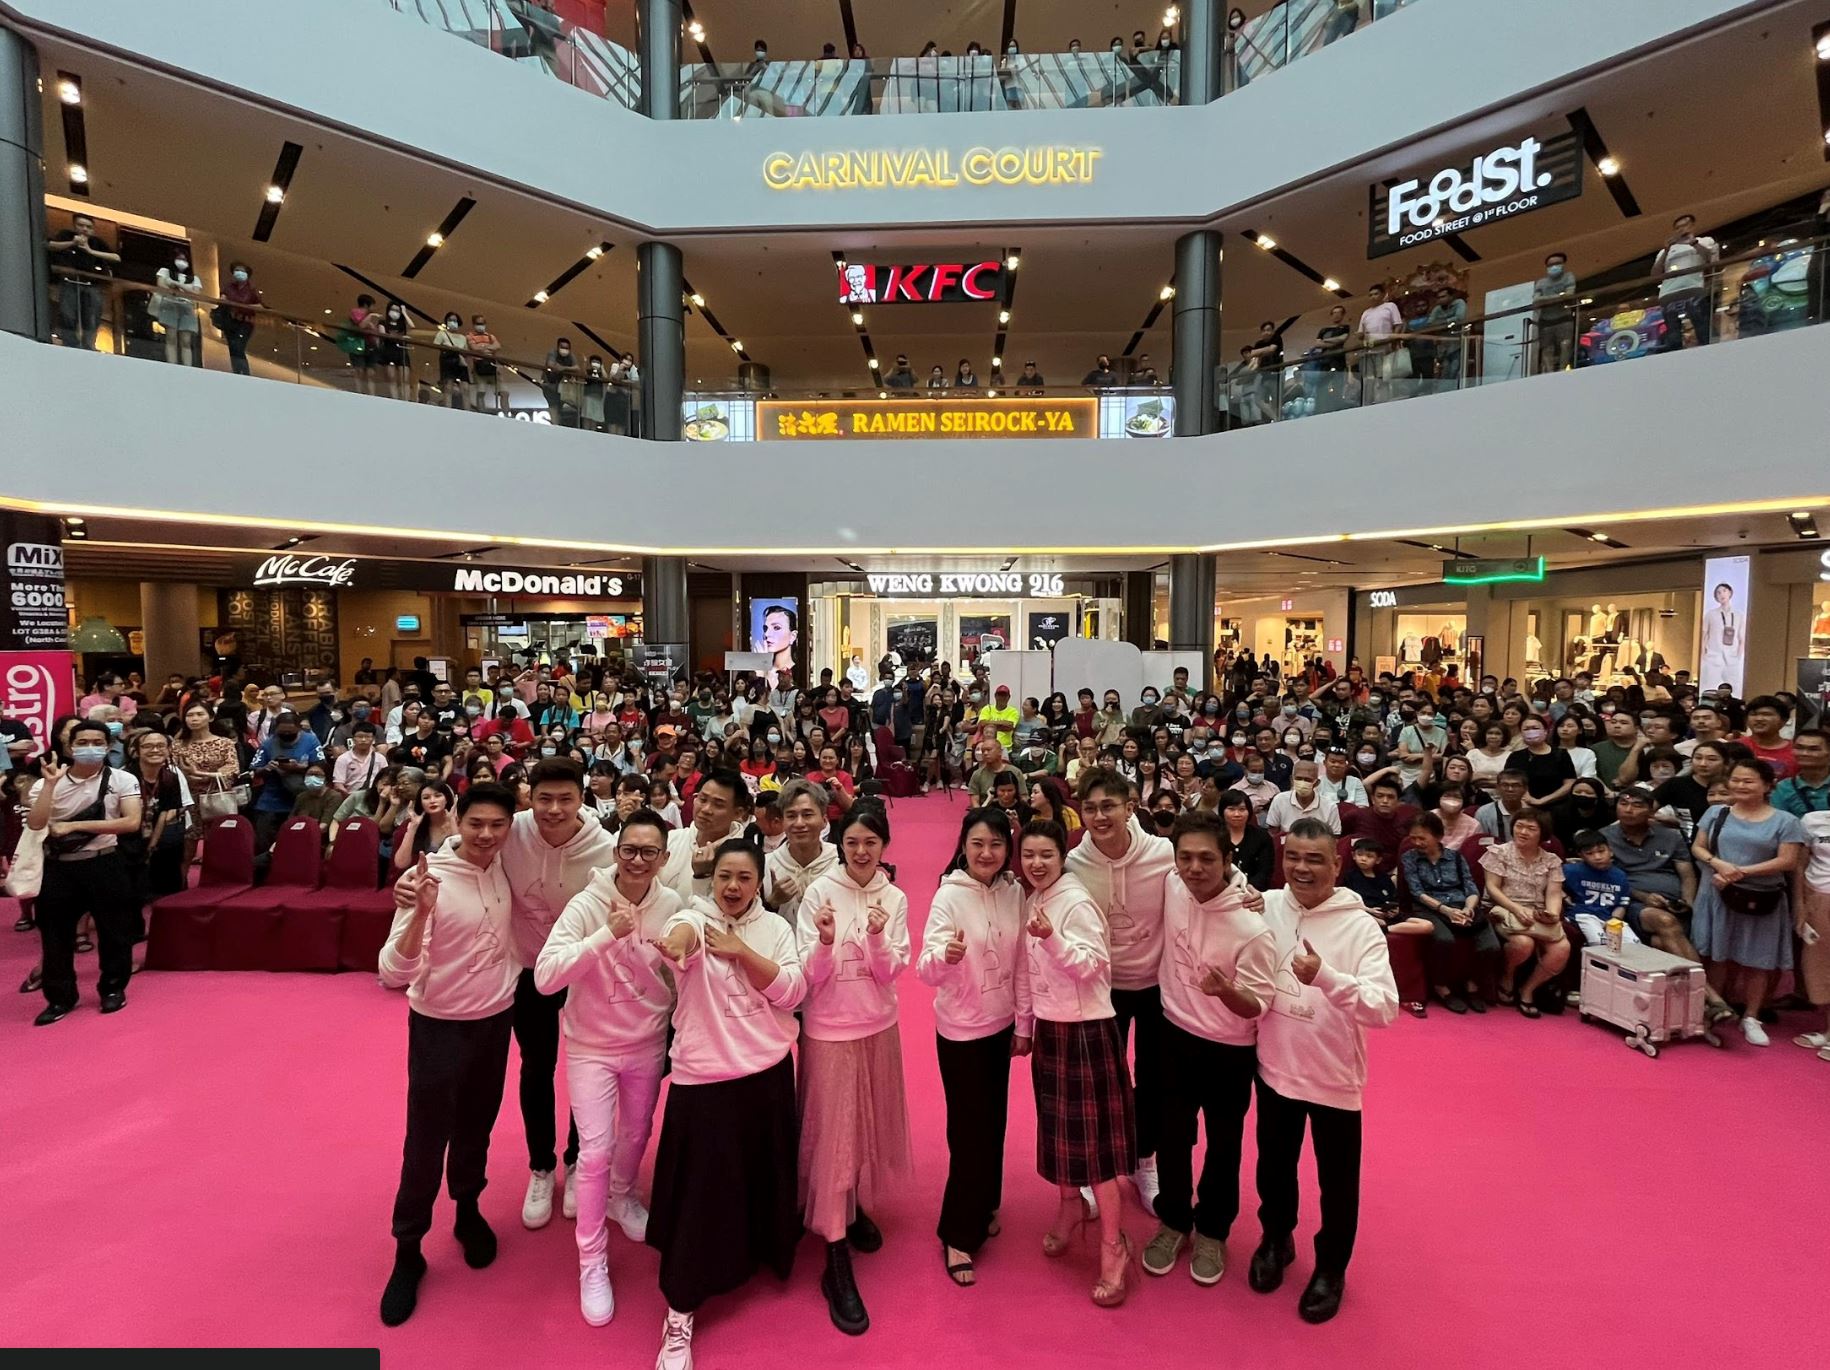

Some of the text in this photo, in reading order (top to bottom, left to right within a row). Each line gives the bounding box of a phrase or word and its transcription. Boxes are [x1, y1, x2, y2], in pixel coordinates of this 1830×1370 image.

[763, 146, 1103, 190] CARNIVAL COURT
[1400, 229, 1433, 246] FOOD
[1434, 215, 1471, 236] STREET
[1496, 195, 1538, 217] FLOOR
[880, 261, 1001, 303] KFC
[852, 411, 1074, 433] RAMEN SEIROCK-YA
[454, 569, 623, 596] McDonald's
[867, 573, 1064, 592] WENG KWONG 916
[1370, 591, 1397, 607] SODA
